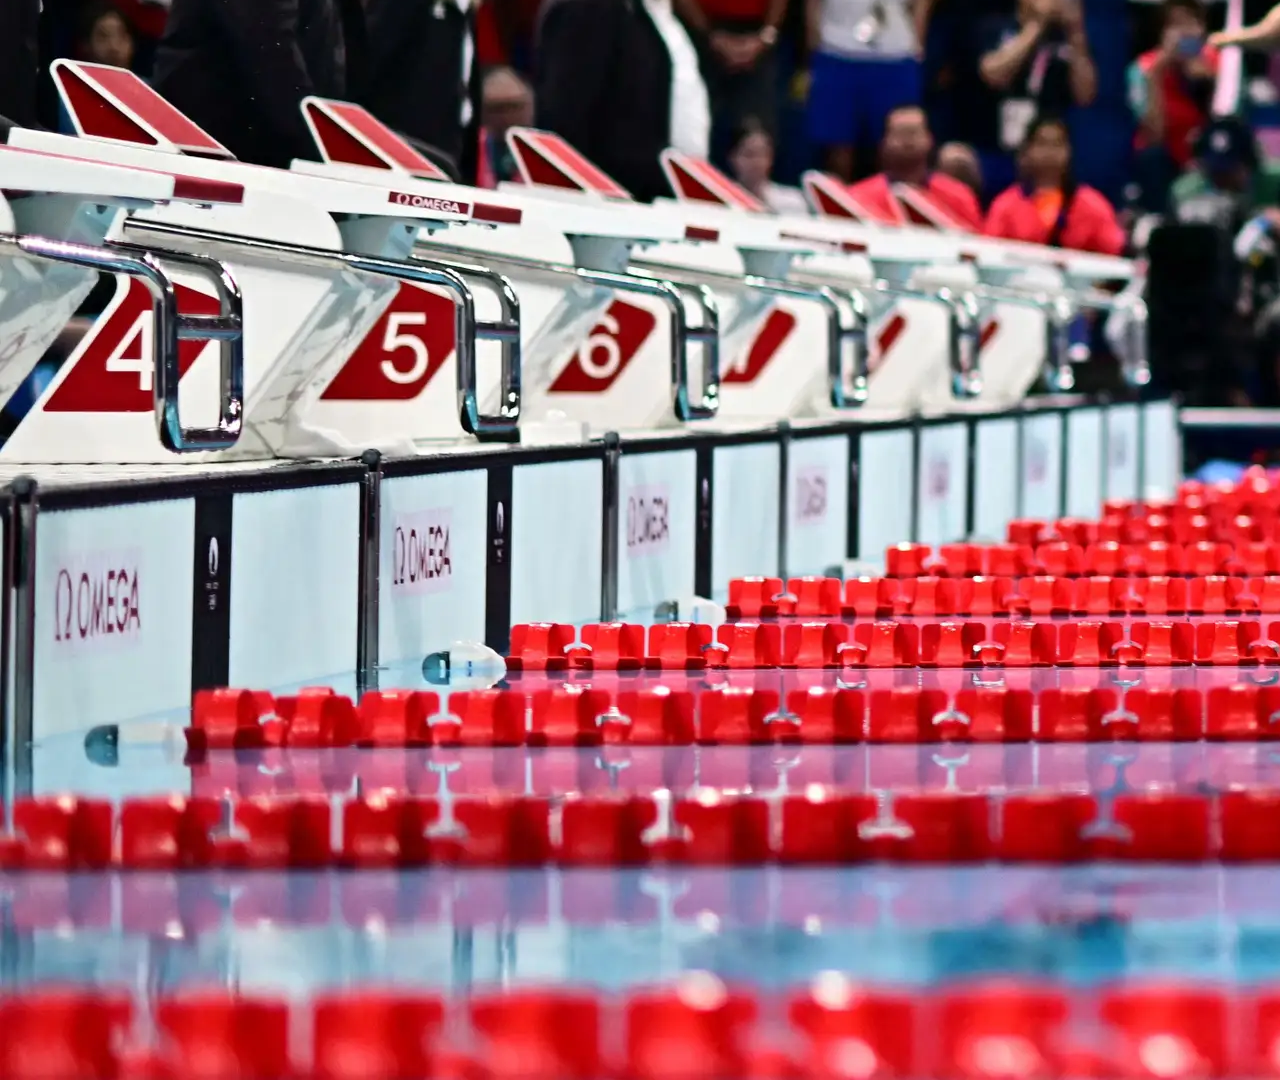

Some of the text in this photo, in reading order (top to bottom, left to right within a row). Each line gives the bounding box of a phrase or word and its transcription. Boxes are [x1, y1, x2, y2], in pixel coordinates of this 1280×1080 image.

[411, 195, 461, 214] OMEGA
[105, 309, 155, 391] 4
[380, 311, 429, 385] 5
[579, 313, 621, 379] 6
[77, 567, 141, 639] OMEGA
